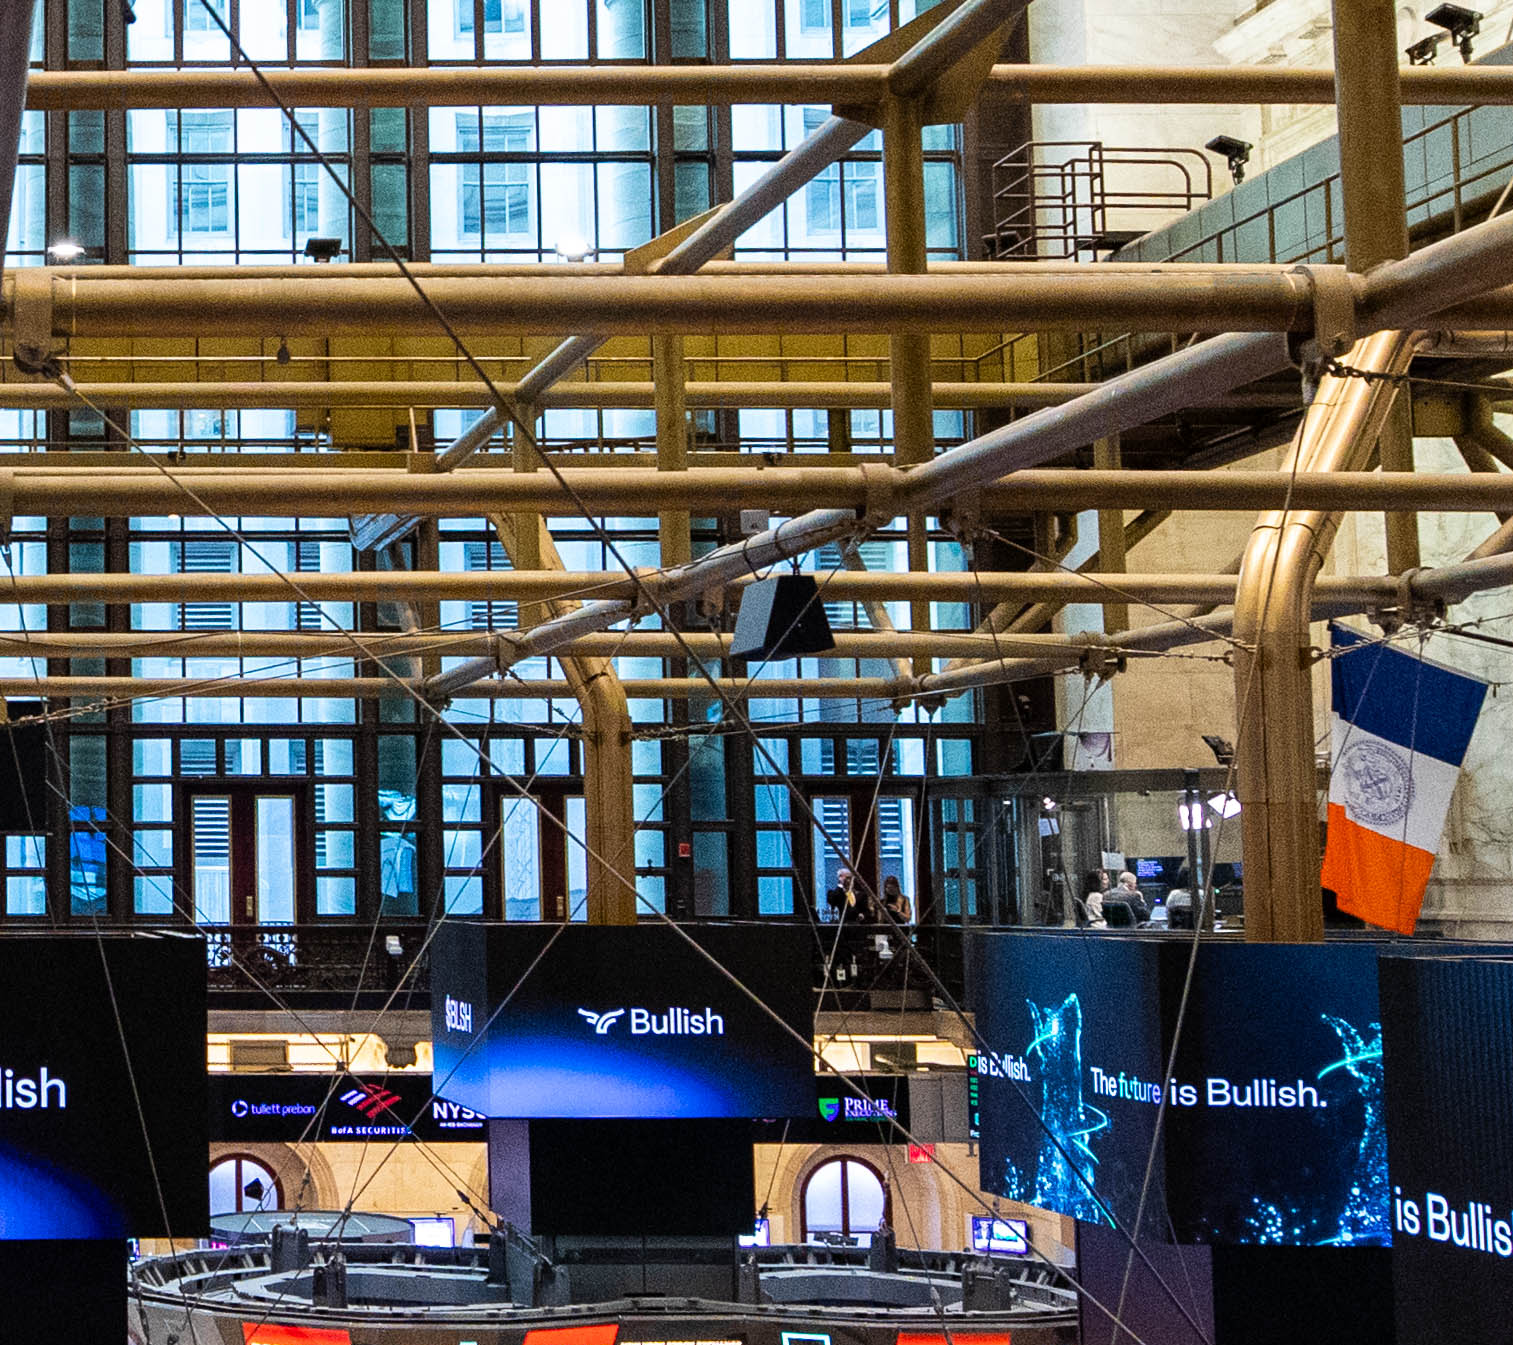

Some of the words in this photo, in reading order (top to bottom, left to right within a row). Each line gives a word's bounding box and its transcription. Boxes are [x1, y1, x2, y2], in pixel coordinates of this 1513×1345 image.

[630, 1007, 724, 1035] Bullish
[1091, 1066, 1117, 1097] The
[1118, 1071, 1161, 1104] future
[1170, 1078, 1198, 1106] is
[1206, 1078, 1327, 1107] Bullish.
[251, 1102, 280, 1116] tullett
[1394, 1185, 1420, 1236] is
